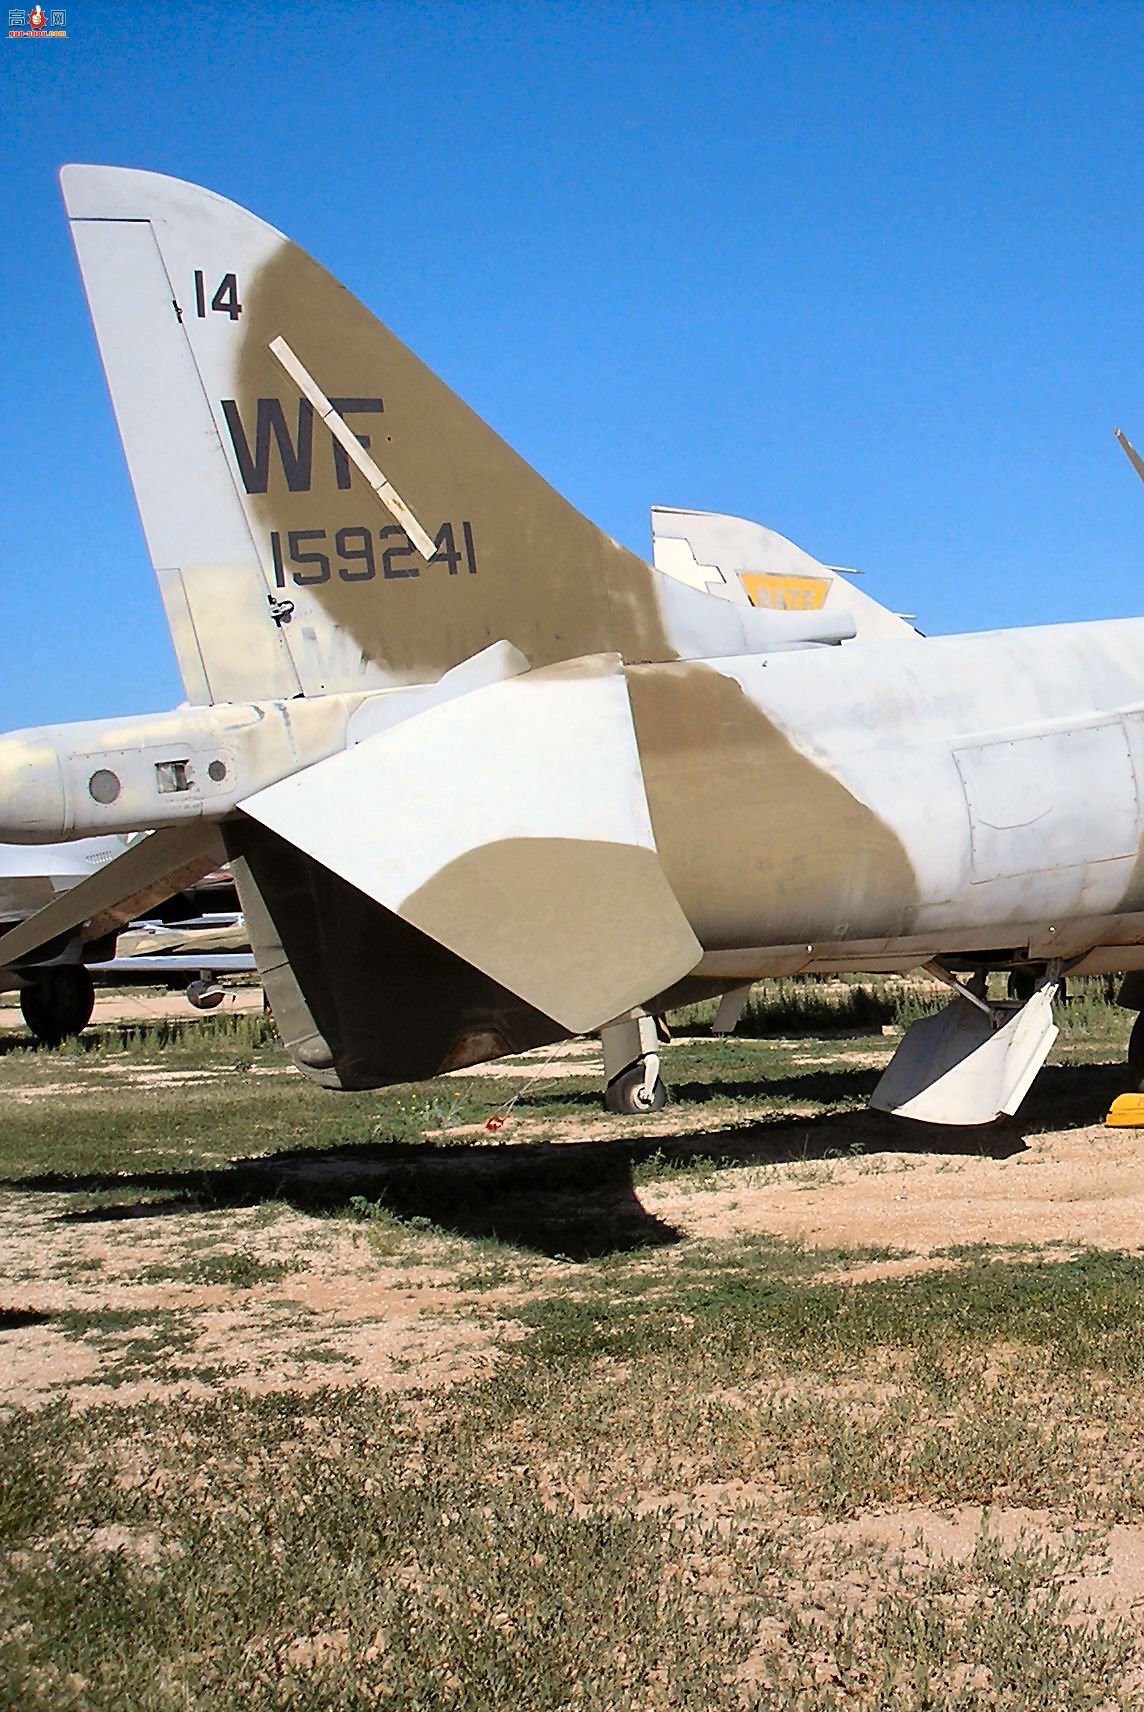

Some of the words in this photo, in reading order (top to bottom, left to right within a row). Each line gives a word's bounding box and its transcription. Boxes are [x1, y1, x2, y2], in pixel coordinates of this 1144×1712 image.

[194, 270, 242, 320] 14
[220, 398, 384, 494] WF
[270, 521, 478, 588] 159241
